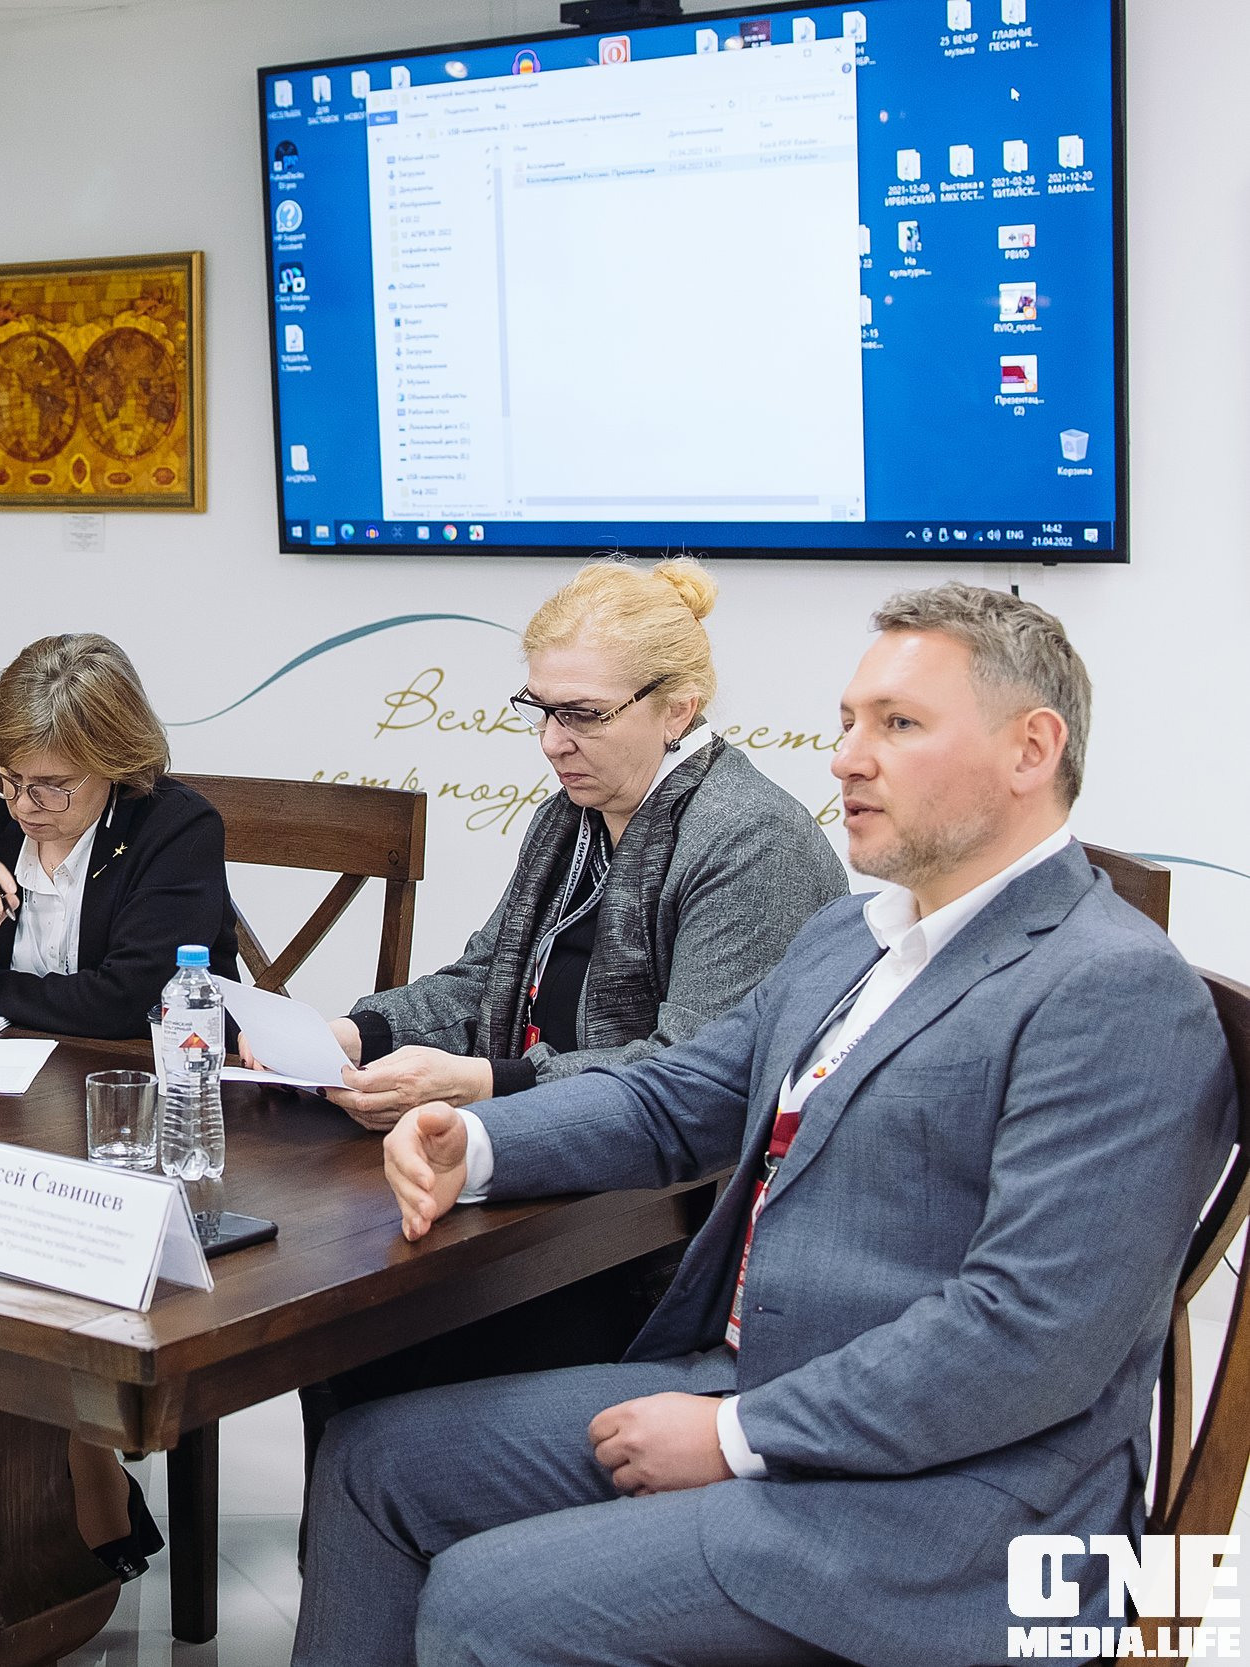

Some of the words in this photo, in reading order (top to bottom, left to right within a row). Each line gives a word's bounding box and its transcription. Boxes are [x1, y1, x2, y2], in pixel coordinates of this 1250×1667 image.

[939, 35, 950, 47] 25
[988, 39, 1021, 52] ПЕСНИ
[1005, 529, 1025, 541] ENG
[1041, 523, 1063, 534] 14:42
[1031, 536, 1073, 547] 21.04.2022
[374, 667, 540, 740] Всяк
[438, 774, 550, 836] подр
[564, 838, 587, 904] ЛТИЙСКИЙ
[32, 1170, 125, 1212] Савищев
